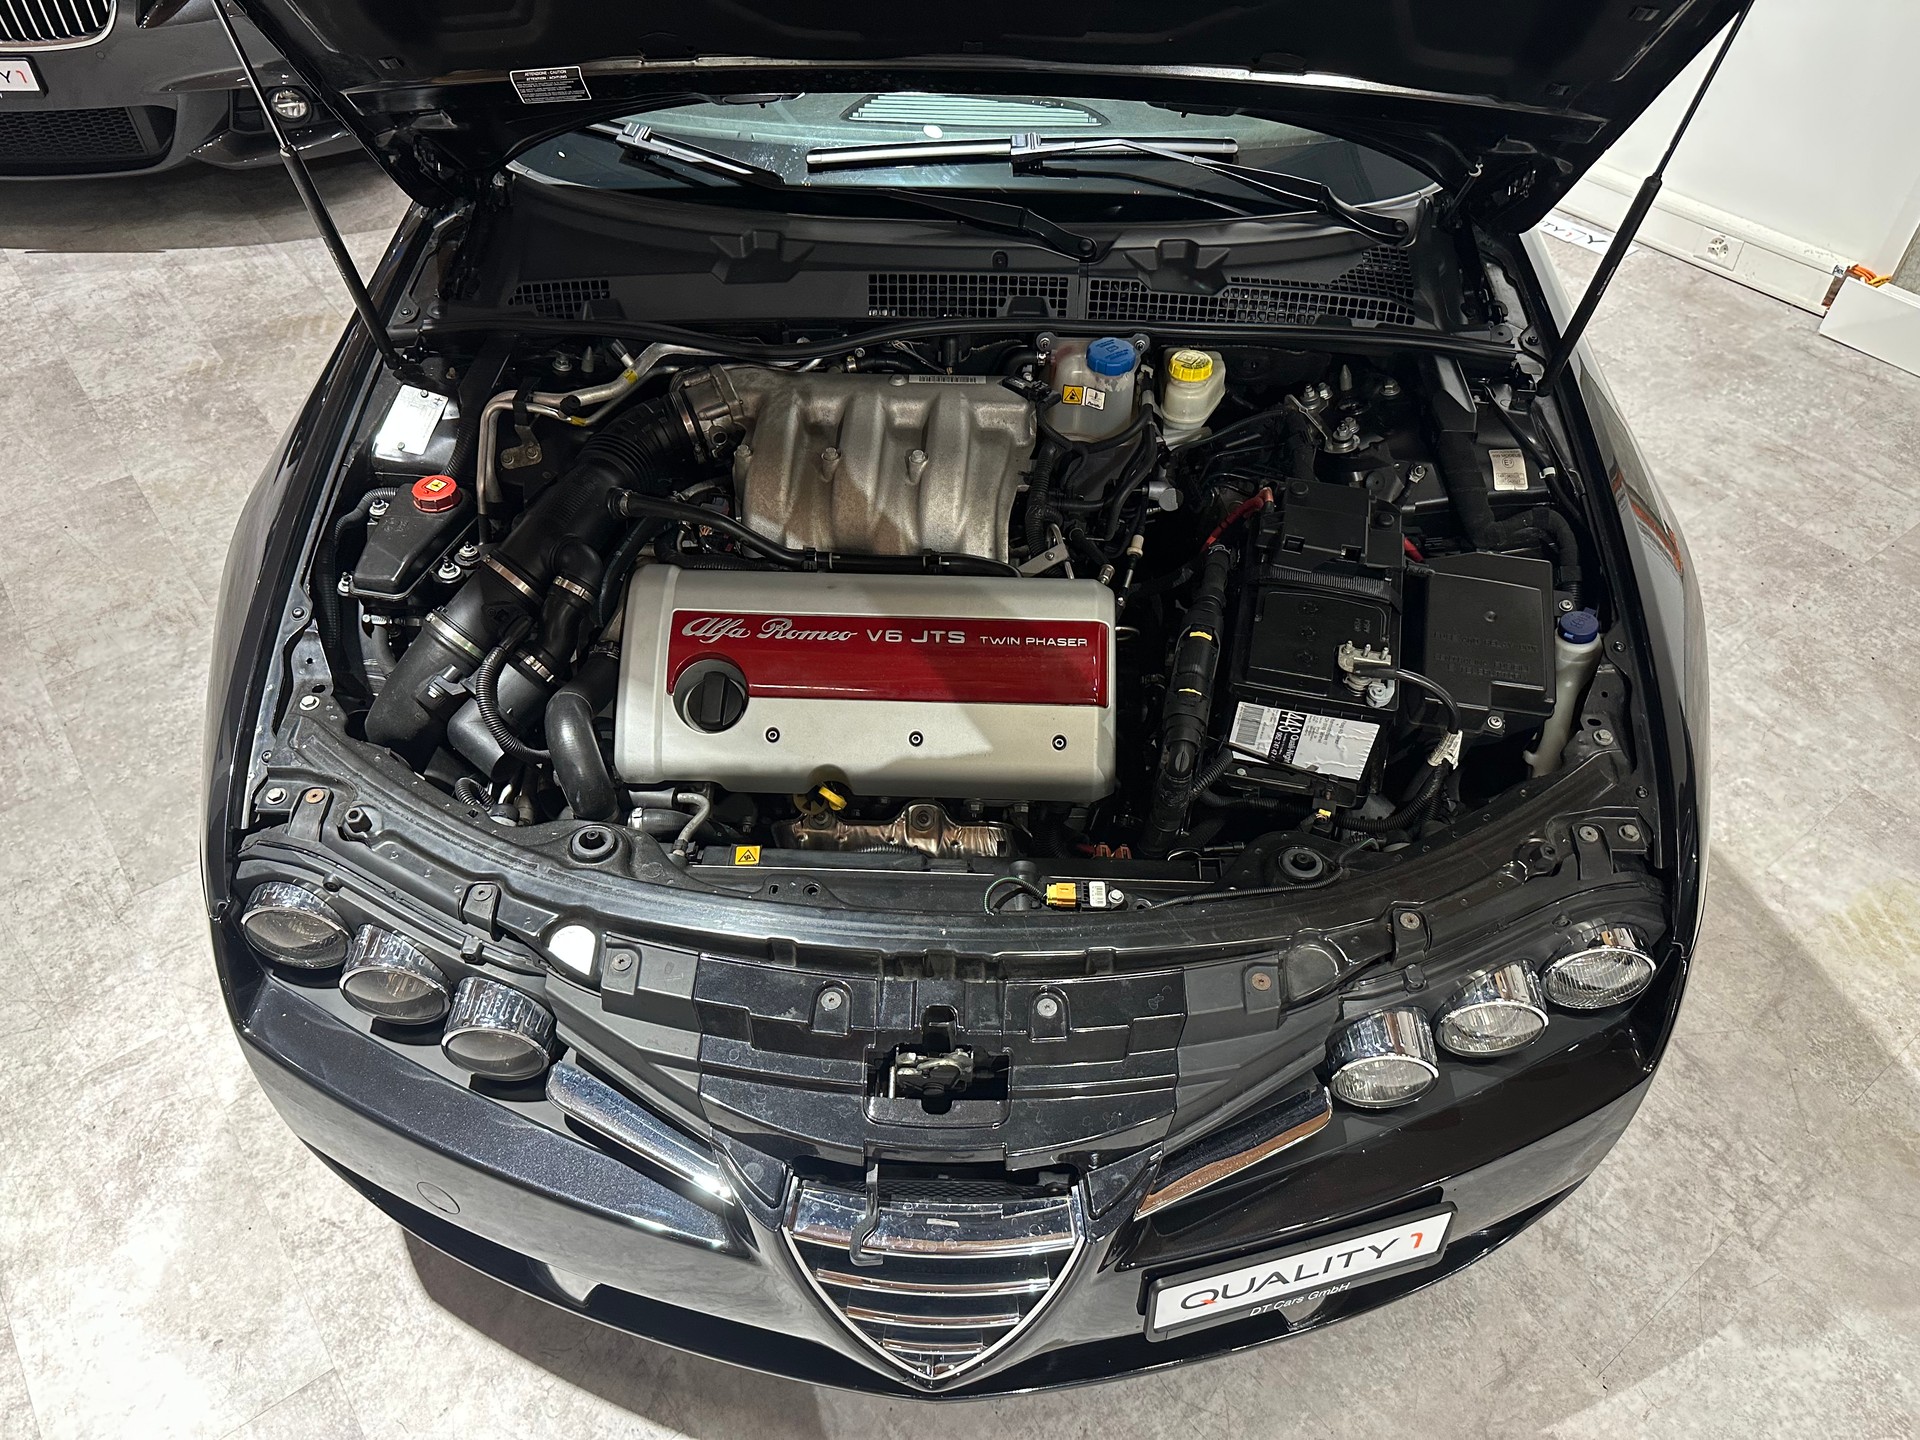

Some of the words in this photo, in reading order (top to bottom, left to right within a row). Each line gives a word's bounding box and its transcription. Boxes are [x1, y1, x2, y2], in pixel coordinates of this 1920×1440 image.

[681, 617, 751, 644] Alfa
[756, 617, 858, 641] Romeo
[866, 629, 903, 643] V6
[910, 630, 966, 644] JTS
[979, 636, 1021, 646] TWIN
[1025, 637, 1088, 647] PHASER
[1278, 712, 1304, 733] 448
[1180, 1237, 1400, 1309] QUALITY
[1410, 1232, 1424, 1249] 1
[1250, 1304, 1273, 1317] DT
[1273, 1296, 1304, 1310] Cars
[1308, 1281, 1351, 1301] GmbH
